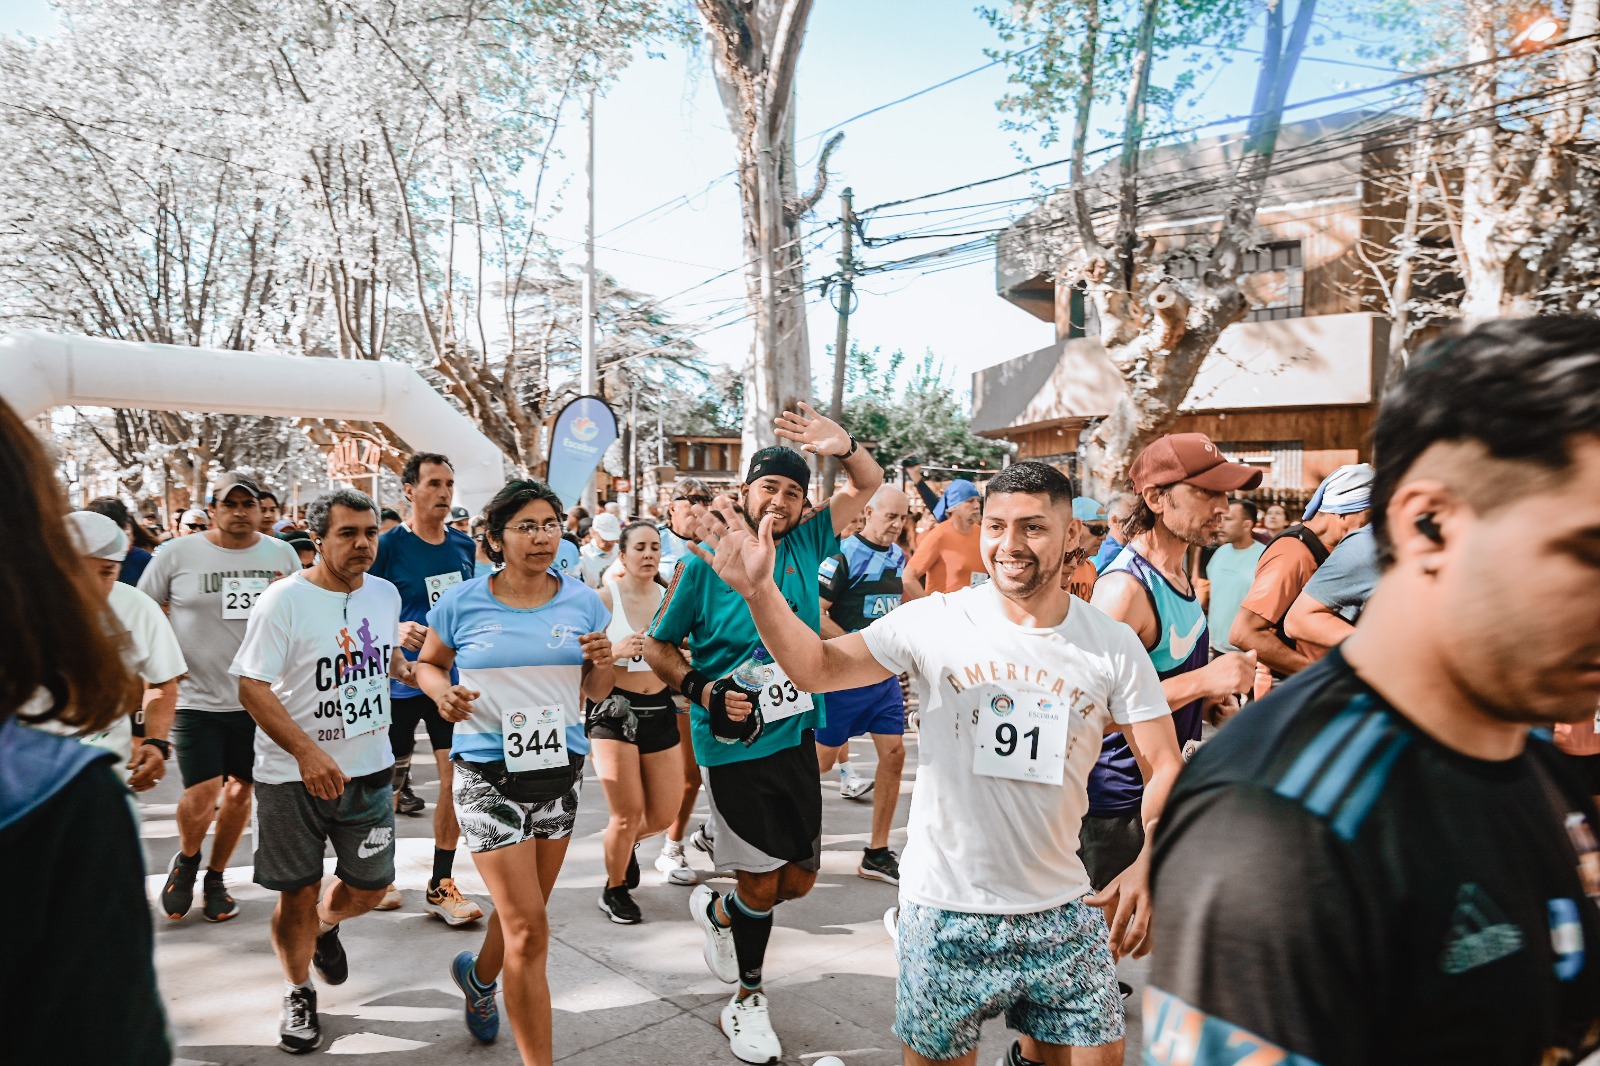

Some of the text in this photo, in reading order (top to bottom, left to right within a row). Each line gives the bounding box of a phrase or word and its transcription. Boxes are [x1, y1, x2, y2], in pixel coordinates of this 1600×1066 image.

[768, 680, 799, 707] 93
[946, 660, 1096, 720] AMERICANA
[344, 693, 383, 725] 341
[317, 728, 346, 741] 2021
[507, 728, 562, 758] 344
[994, 722, 1040, 760] 91
